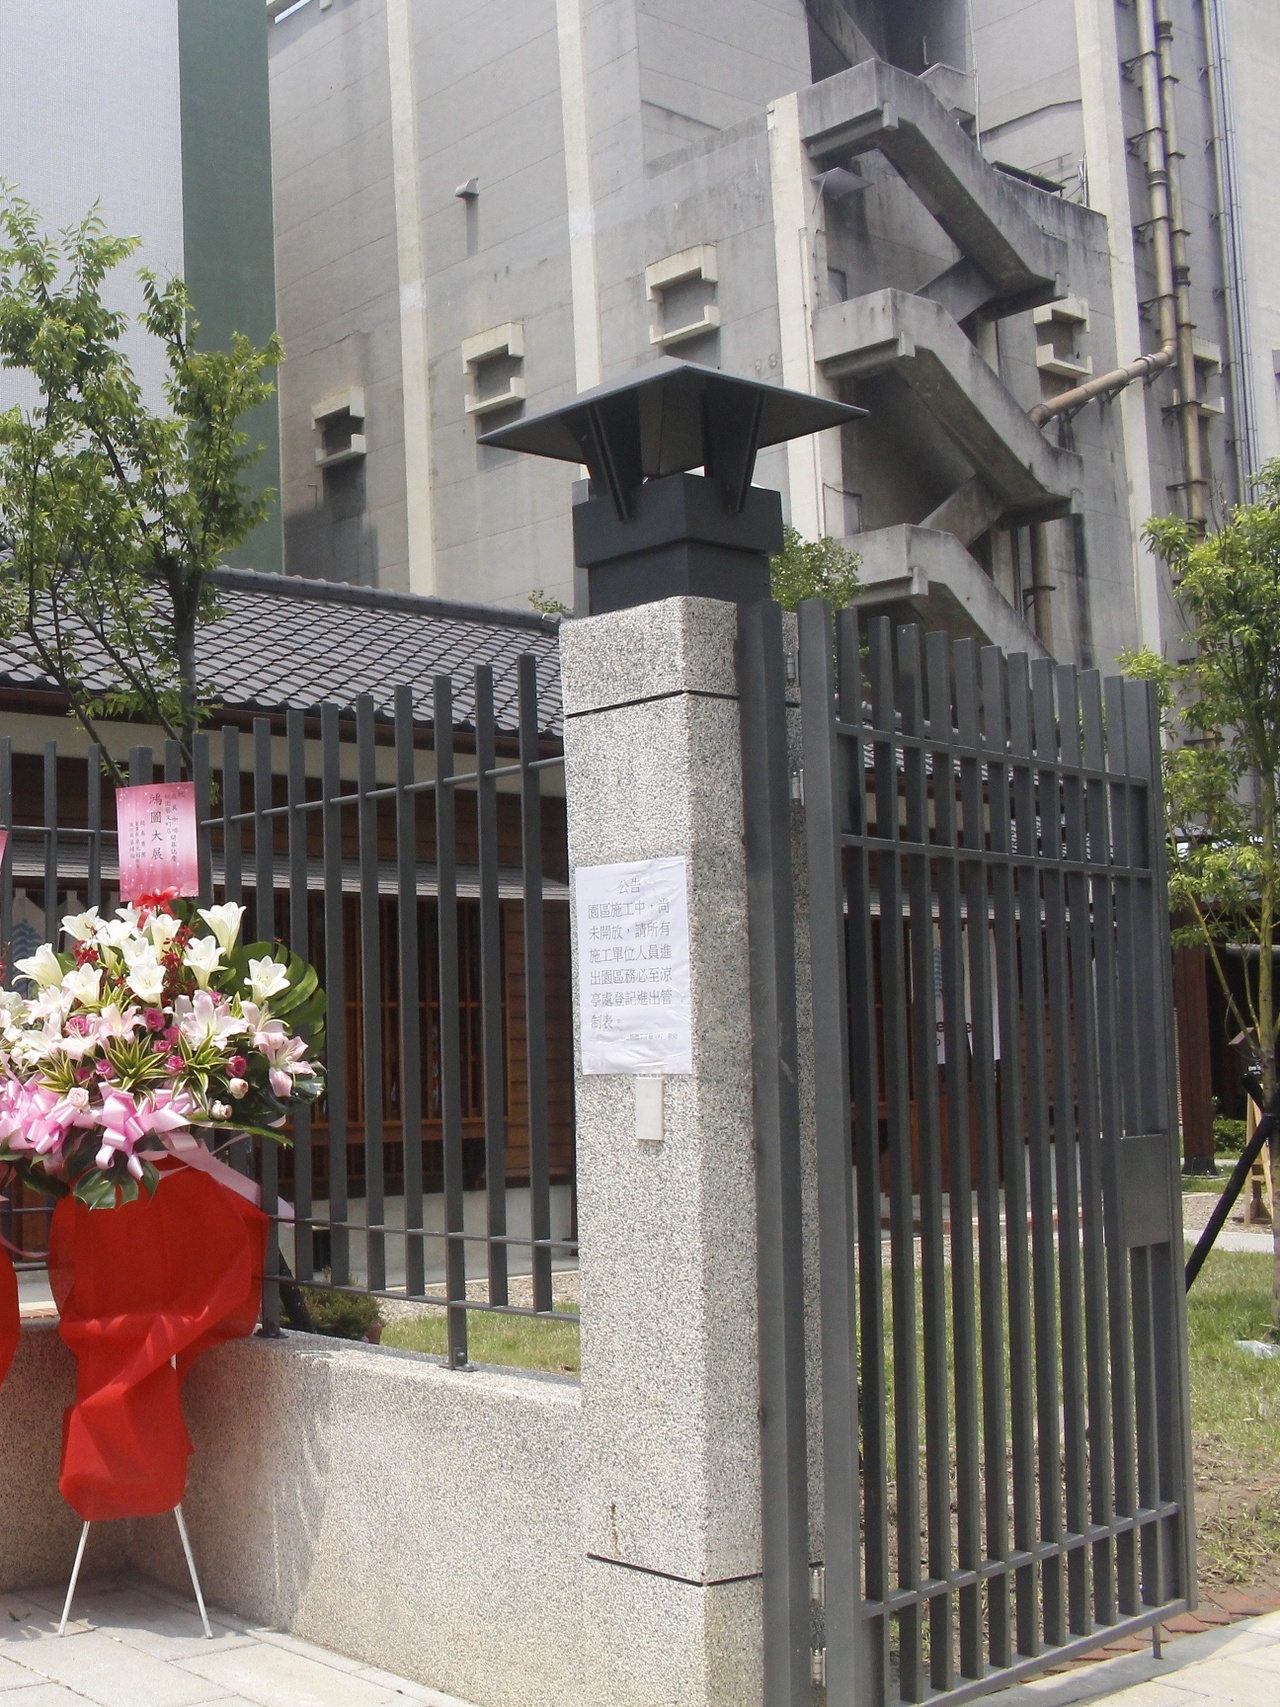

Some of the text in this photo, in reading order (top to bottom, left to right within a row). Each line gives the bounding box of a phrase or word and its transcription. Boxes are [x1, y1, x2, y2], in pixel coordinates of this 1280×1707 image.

[149, 793, 164, 860] 鴻圖大展
[619, 878, 641, 894] 公告
[589, 943, 672, 963] 施工單位人員進
[590, 966, 673, 985] 出園區務必至涼
[591, 989, 673, 1007] 亭處登記進出管
